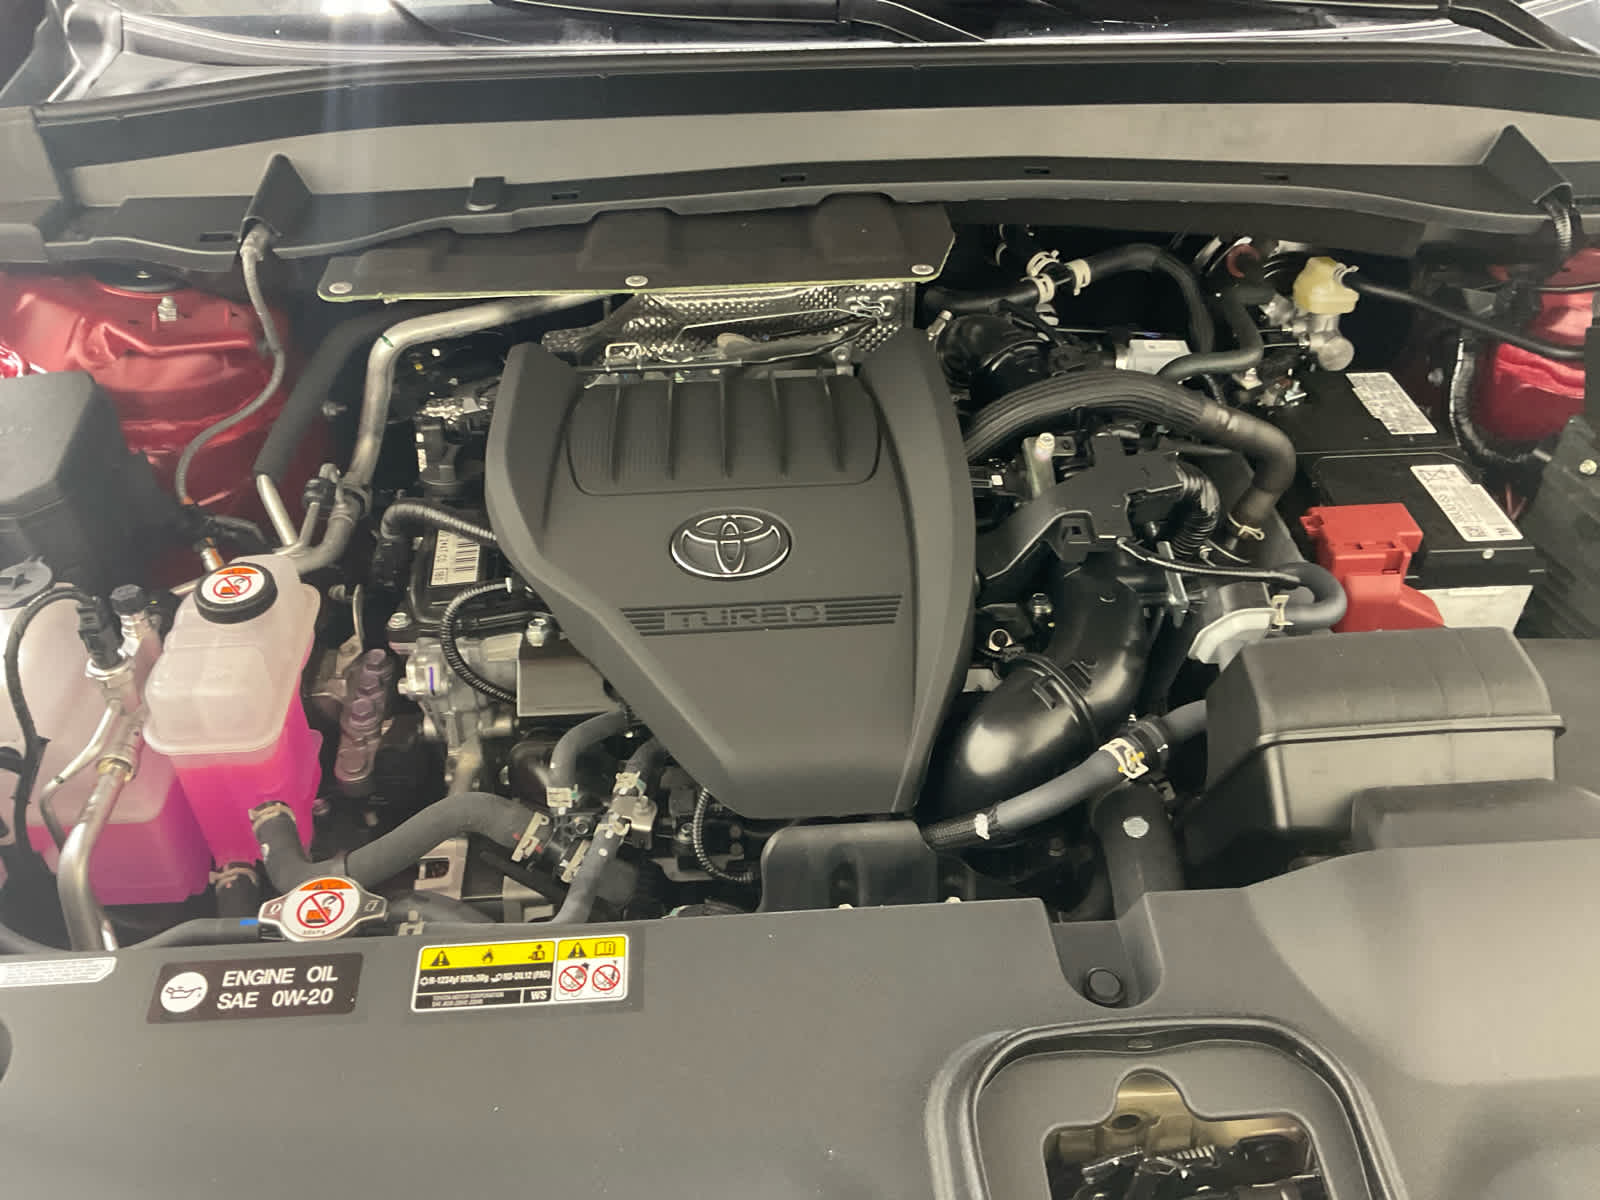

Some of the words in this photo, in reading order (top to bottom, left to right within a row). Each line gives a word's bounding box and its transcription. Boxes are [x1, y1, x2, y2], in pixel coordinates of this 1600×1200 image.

[668, 604, 822, 627] TURBO
[222, 967, 295, 987] ENGINE
[306, 966, 338, 983] OIL
[217, 991, 259, 1009] SAE
[271, 988, 333, 1007] 0W-20
[531, 990, 547, 1000] WS
